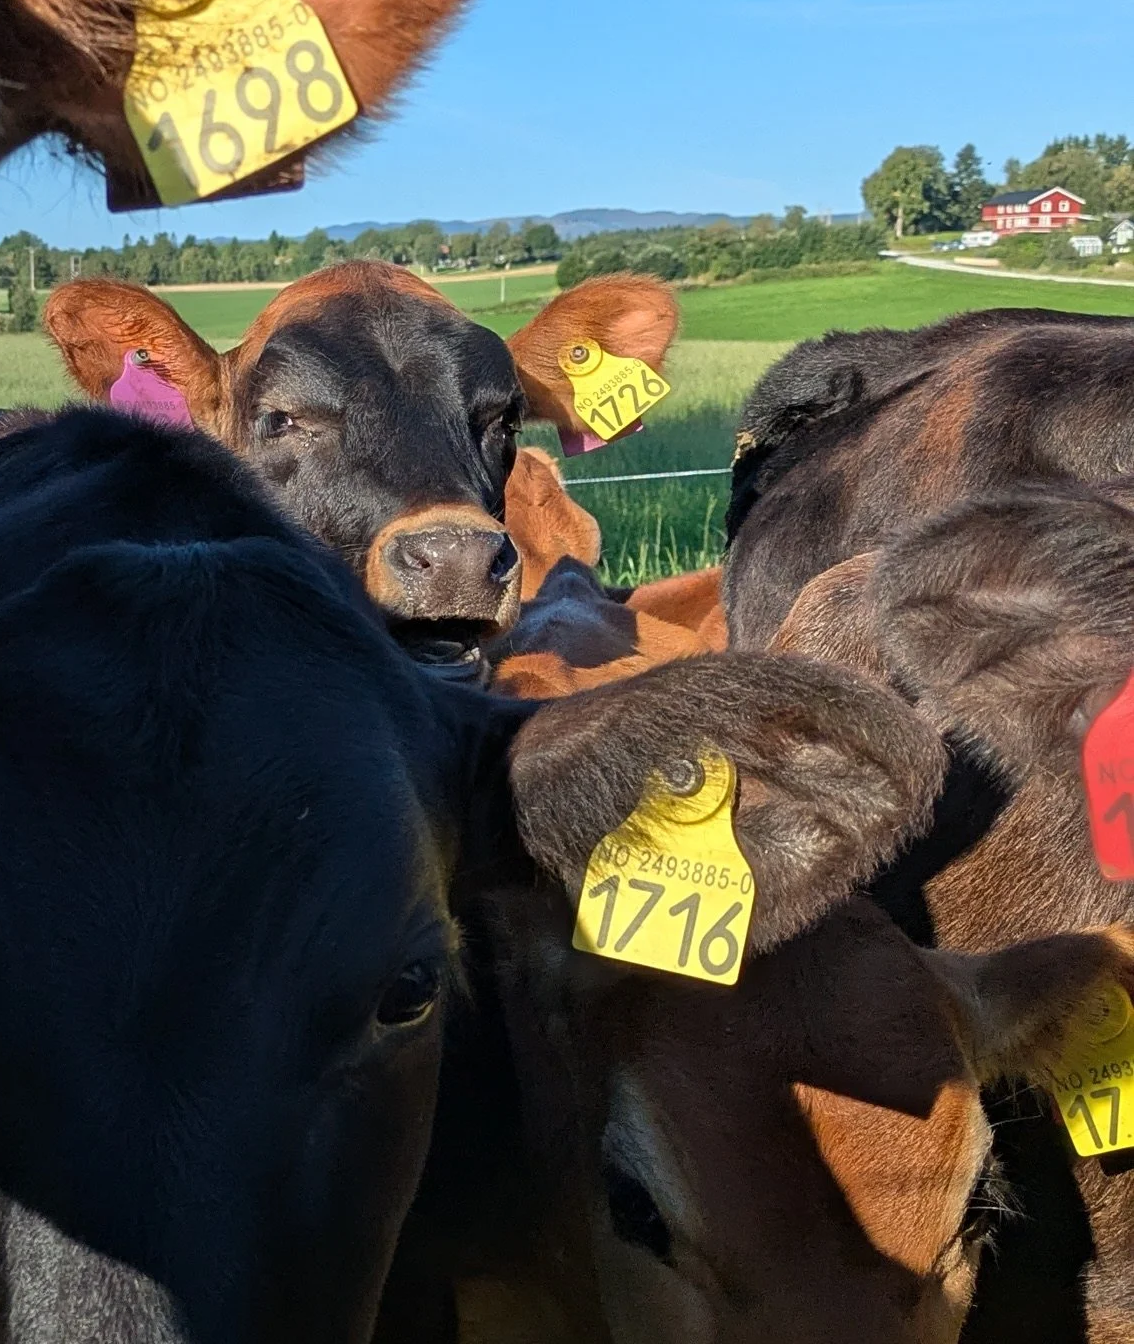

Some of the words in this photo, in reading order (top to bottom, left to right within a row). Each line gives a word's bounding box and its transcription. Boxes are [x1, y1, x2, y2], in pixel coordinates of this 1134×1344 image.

[130, 75, 168, 109] NO
[146, 39, 343, 196] 1698
[575, 398, 593, 412] NO
[592, 359, 642, 400] 2493885-0
[589, 368, 665, 432] 1726
[598, 843, 630, 868] NO
[637, 850, 753, 895] 2493885-0
[588, 874, 744, 976] 1716
[1067, 1086, 1121, 1149] 17
